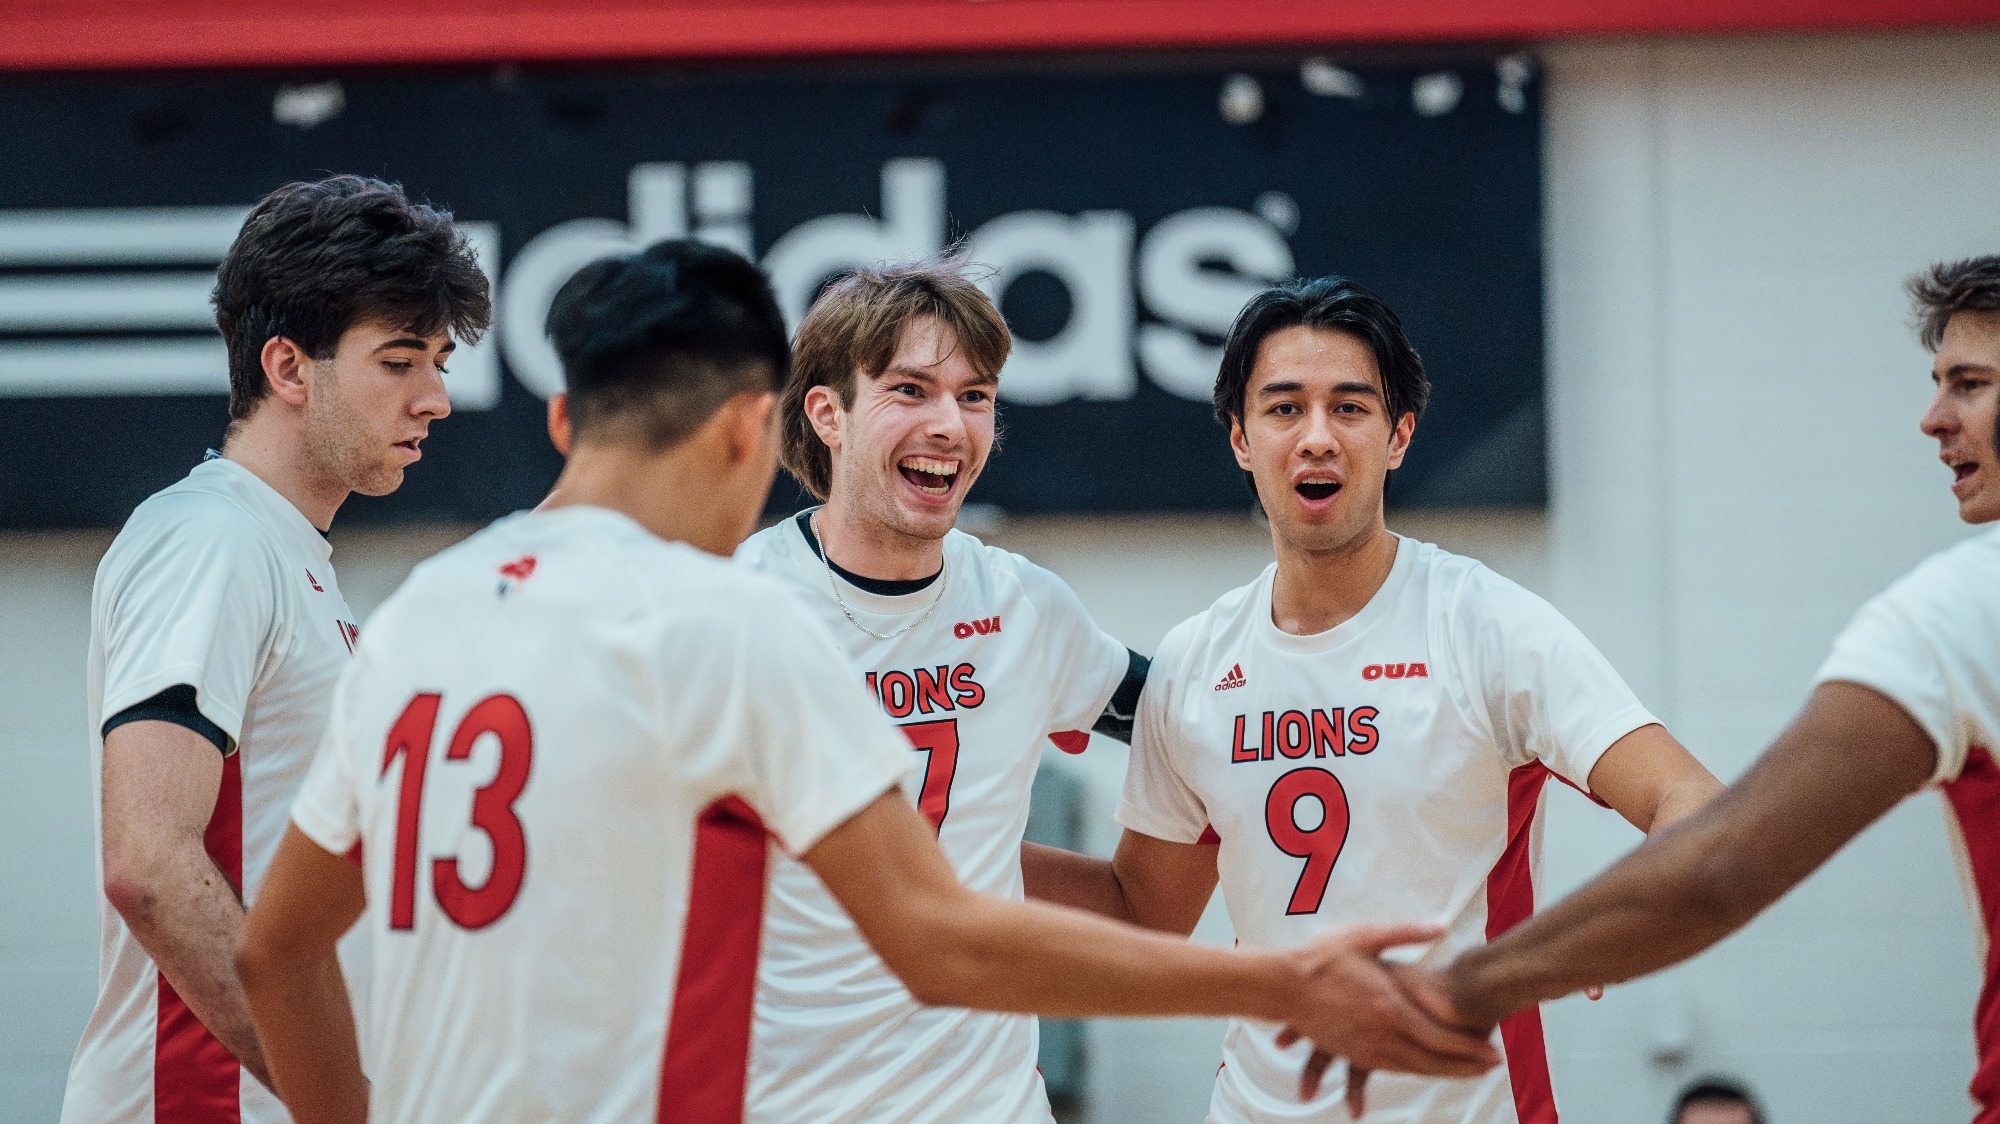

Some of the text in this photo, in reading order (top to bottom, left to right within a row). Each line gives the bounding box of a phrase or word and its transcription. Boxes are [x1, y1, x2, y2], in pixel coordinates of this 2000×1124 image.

[953, 616, 1001, 639] OUA
[865, 662, 985, 719] IONS
[1214, 679, 1247, 691] adidas
[1362, 663, 1428, 681] OUA
[1231, 706, 1380, 764] LIONS
[891, 717, 960, 842] 7
[379, 691, 534, 932] 13
[1264, 766, 1350, 916] 9
